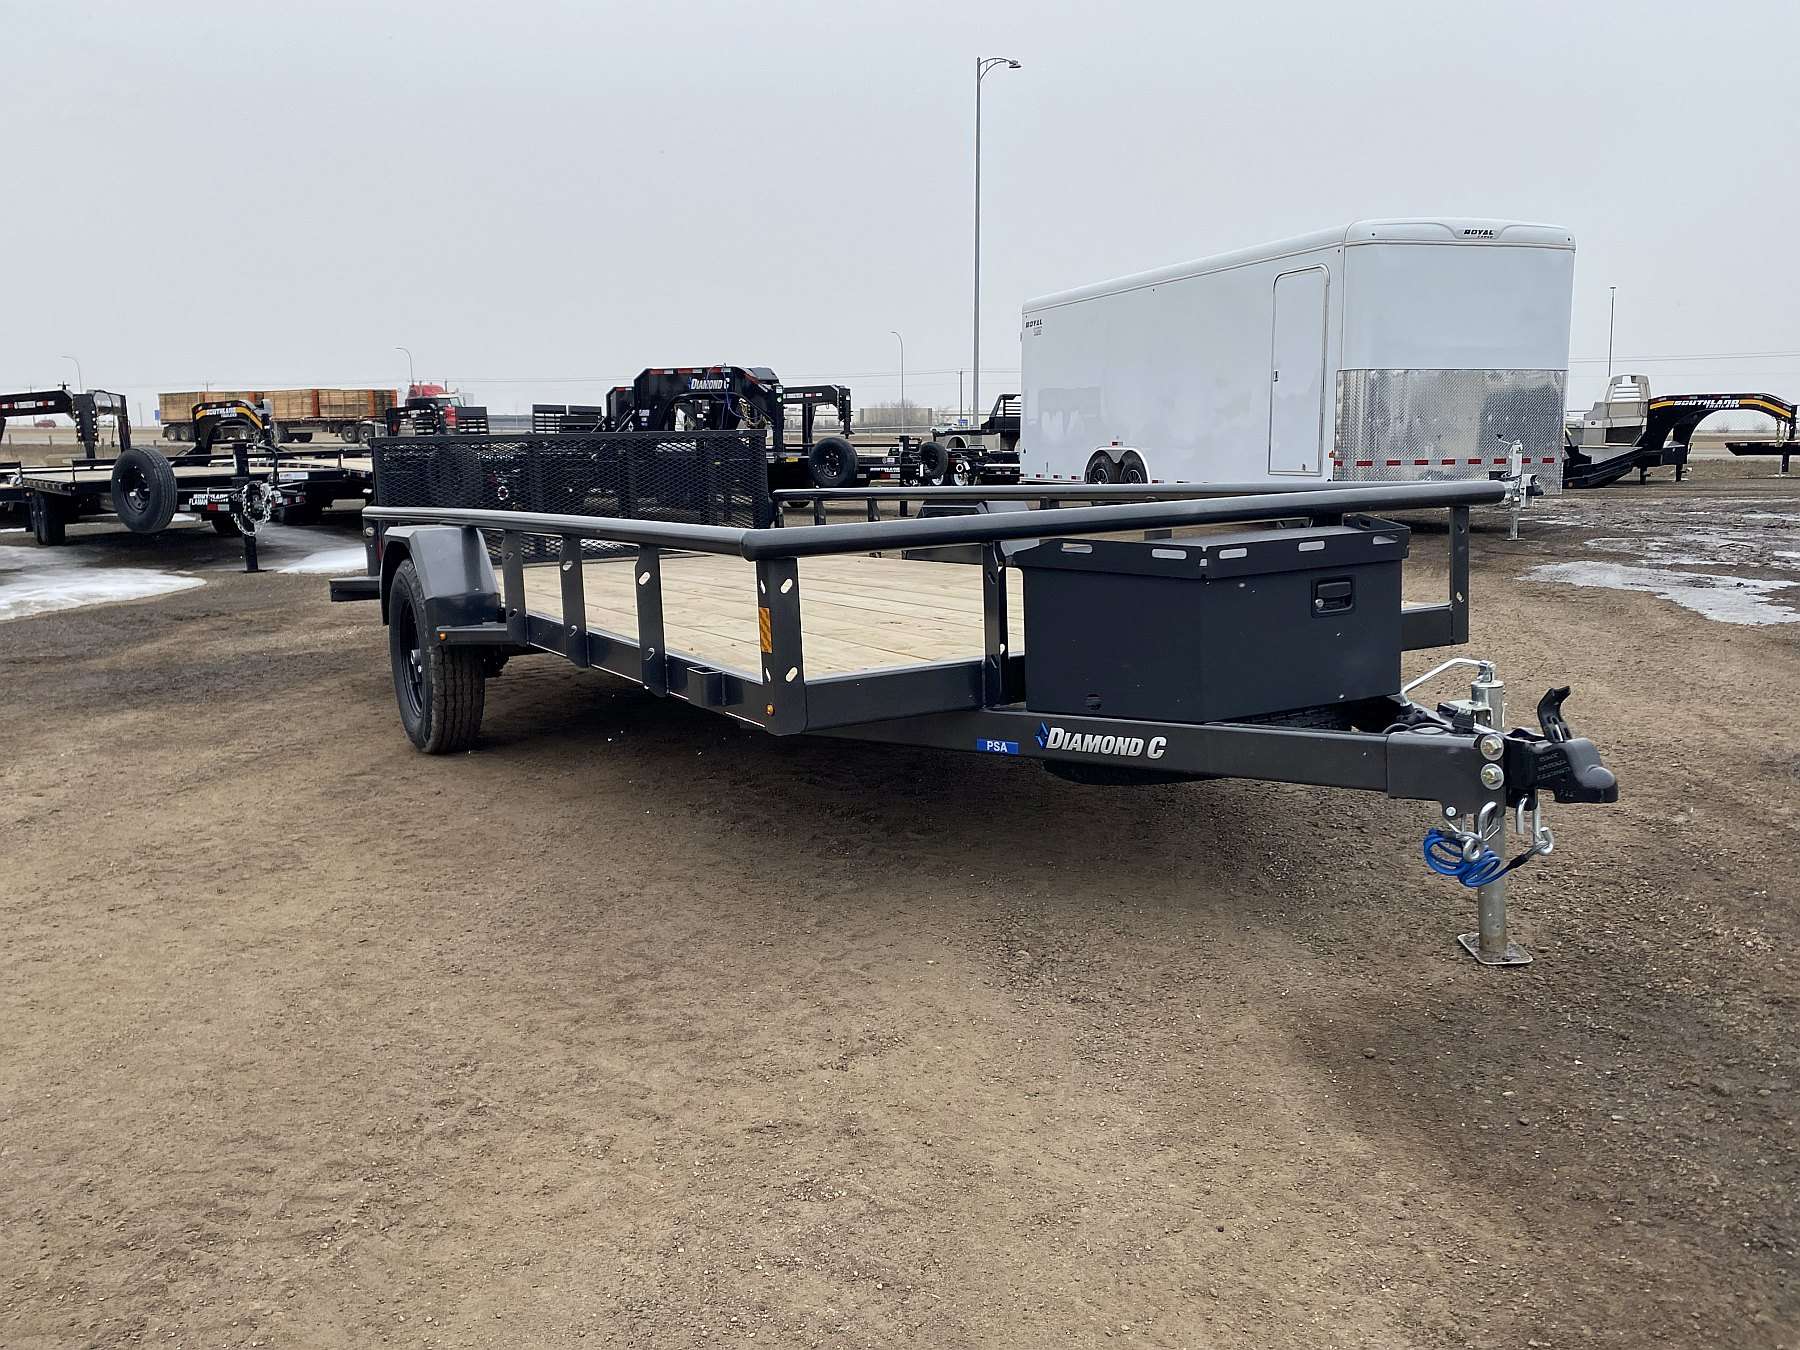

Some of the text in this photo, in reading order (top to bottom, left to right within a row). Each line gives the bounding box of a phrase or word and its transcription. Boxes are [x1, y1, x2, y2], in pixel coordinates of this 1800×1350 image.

[1025, 319, 1042, 328] ROYAL
[691, 377, 730, 390] DIAMOND C
[986, 740, 1008, 753] PSA
[1046, 727, 1167, 760] DIAMOND C
